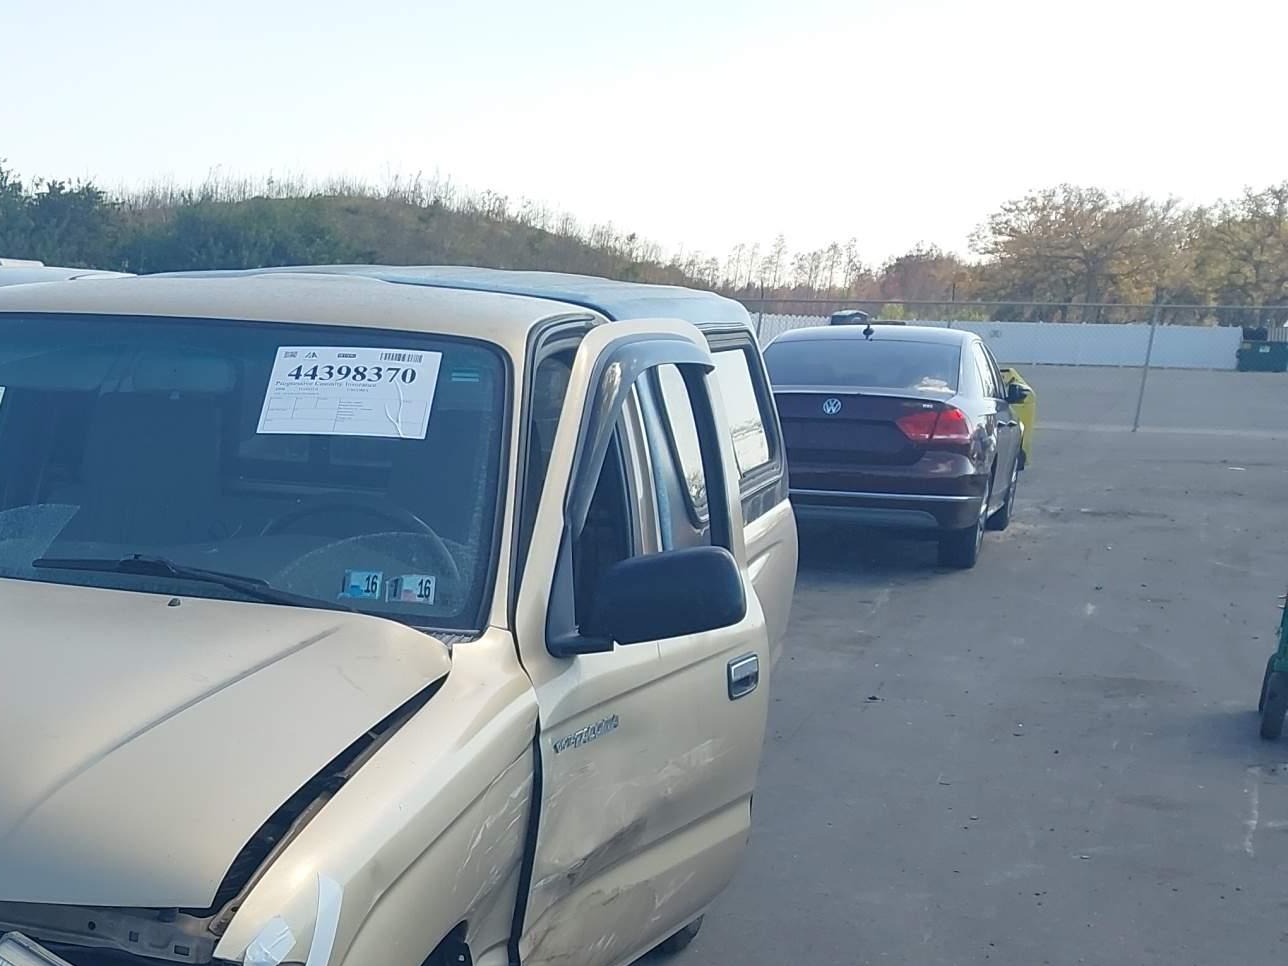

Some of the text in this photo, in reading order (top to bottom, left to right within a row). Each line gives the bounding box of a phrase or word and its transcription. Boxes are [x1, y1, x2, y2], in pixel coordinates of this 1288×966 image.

[288, 364, 417, 384] 44398370
[364, 574, 379, 594] 16
[417, 578, 432, 599] 16
